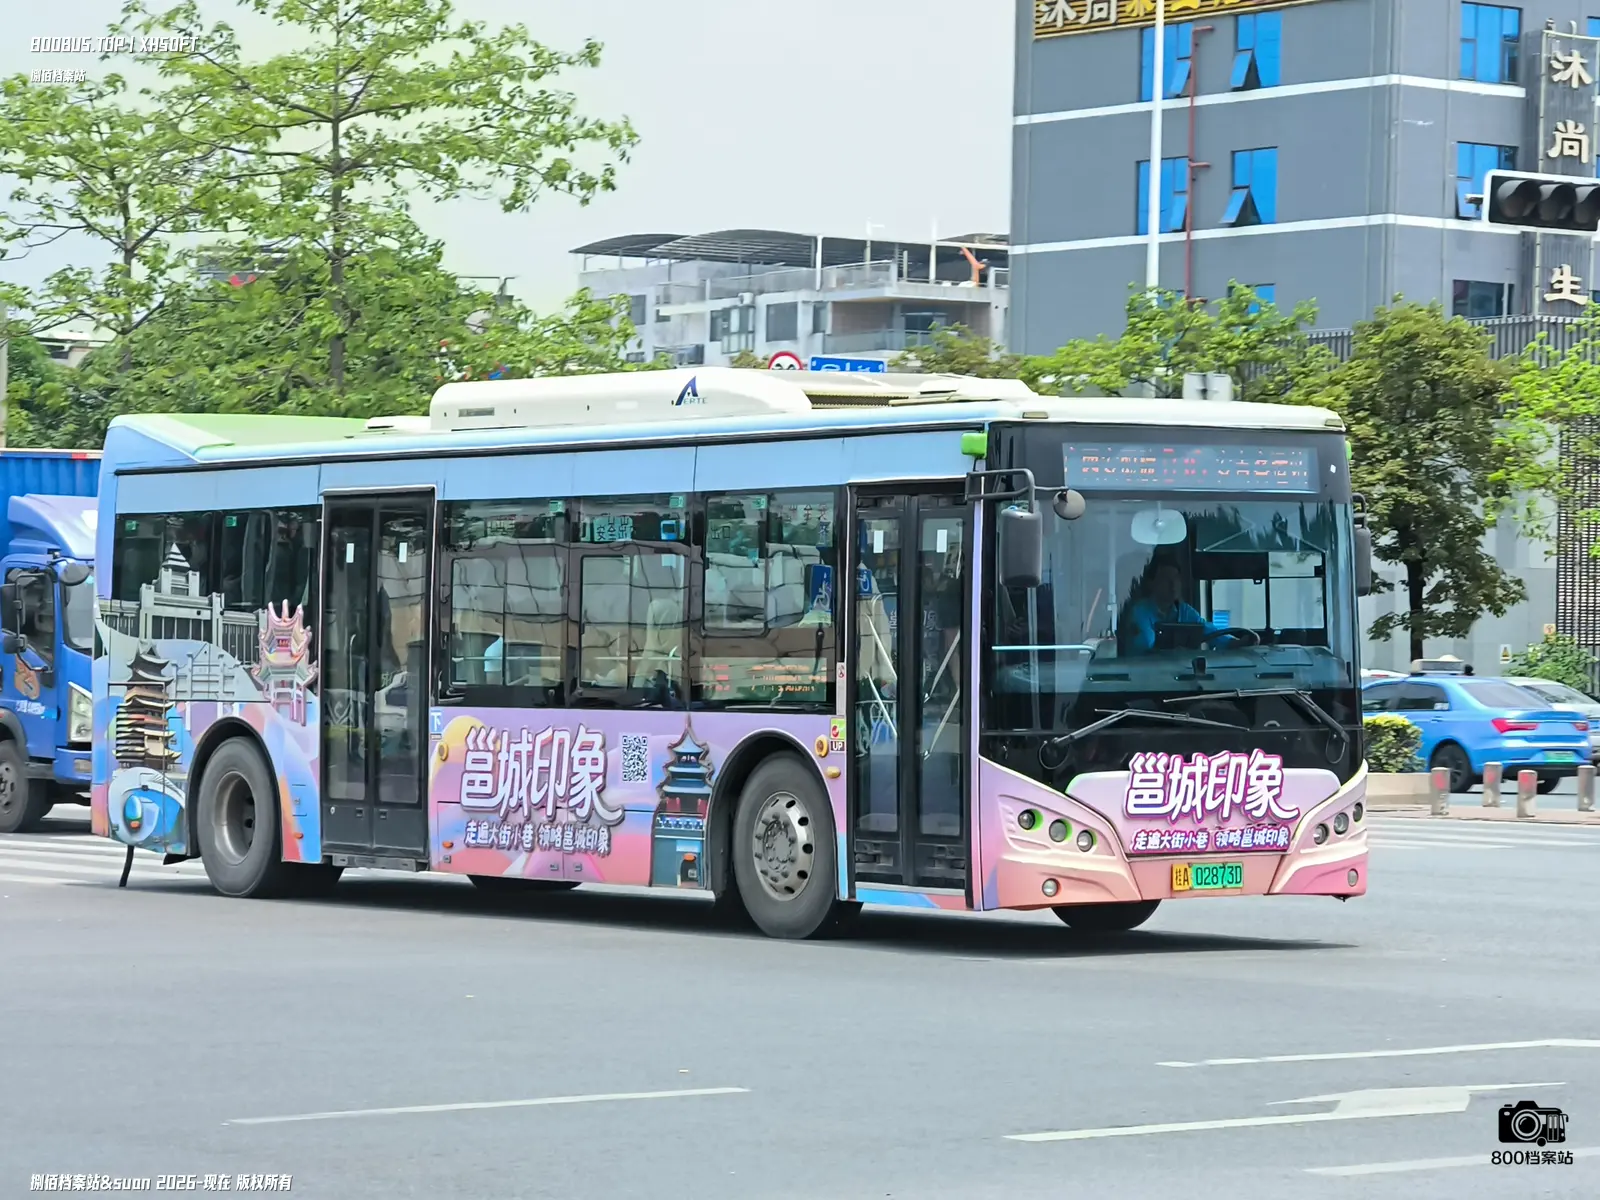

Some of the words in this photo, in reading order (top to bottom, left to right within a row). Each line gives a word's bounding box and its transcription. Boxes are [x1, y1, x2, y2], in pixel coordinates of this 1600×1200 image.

[1544, 50, 1593, 306] 沐尚生
[832, 740, 844, 751] UP
[460, 723, 625, 826] 邕城印象
[1124, 748, 1300, 824] 邕城印象
[465, 820, 534, 849] 走遍大街小巷
[538, 823, 610, 856] 领略邕城印象
[1133, 830, 1210, 852] 走遍大街小巷
[1215, 826, 1291, 850] 领略邕城印象
[1195, 864, 1243, 887] 02873D
